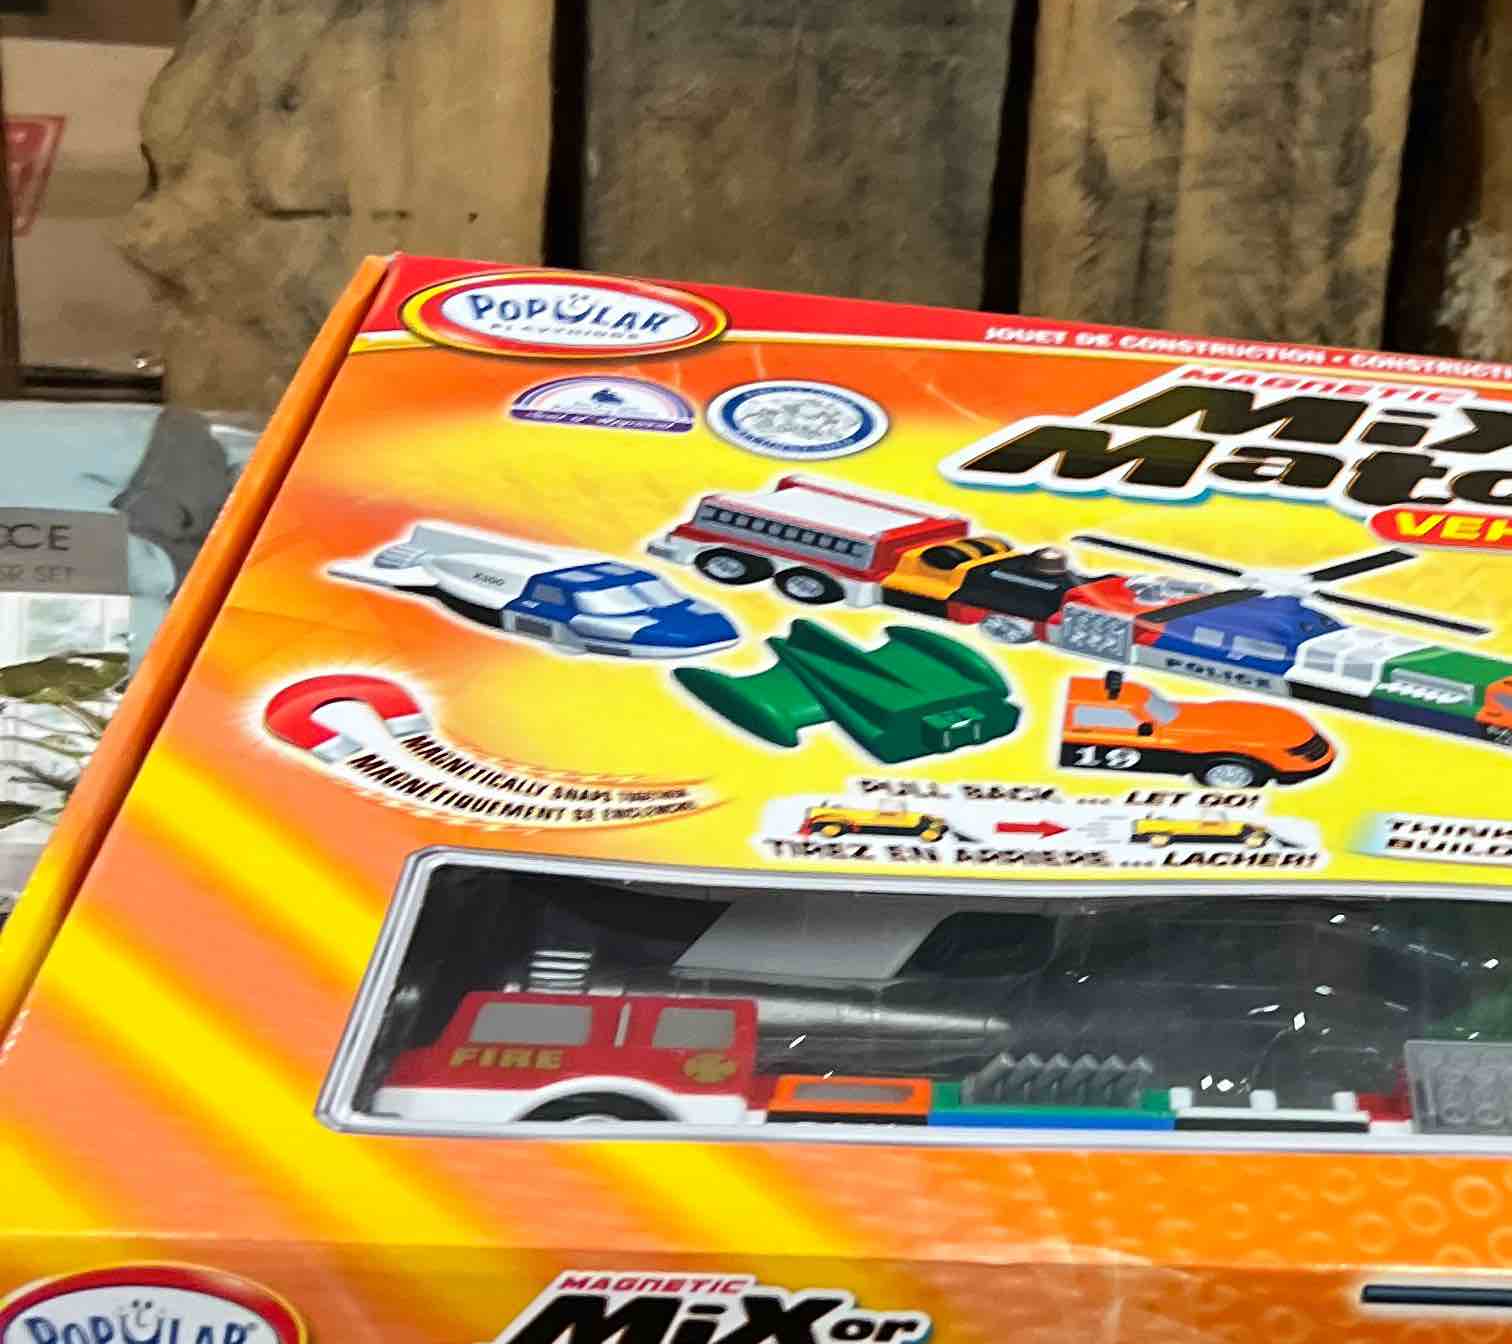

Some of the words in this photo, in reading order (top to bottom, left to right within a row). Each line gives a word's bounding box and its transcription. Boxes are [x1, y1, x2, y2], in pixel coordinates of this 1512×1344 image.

[467, 292, 674, 332] POPULAR
[1119, 335, 1326, 364] CONSTRUCTION
[1179, 367, 1470, 403] MAGNETIC
[1072, 746, 1142, 768] 19
[1123, 789, 1191, 806] LET
[448, 1047, 565, 1071] FIRE
[560, 1275, 754, 1294] MAGNETIC
